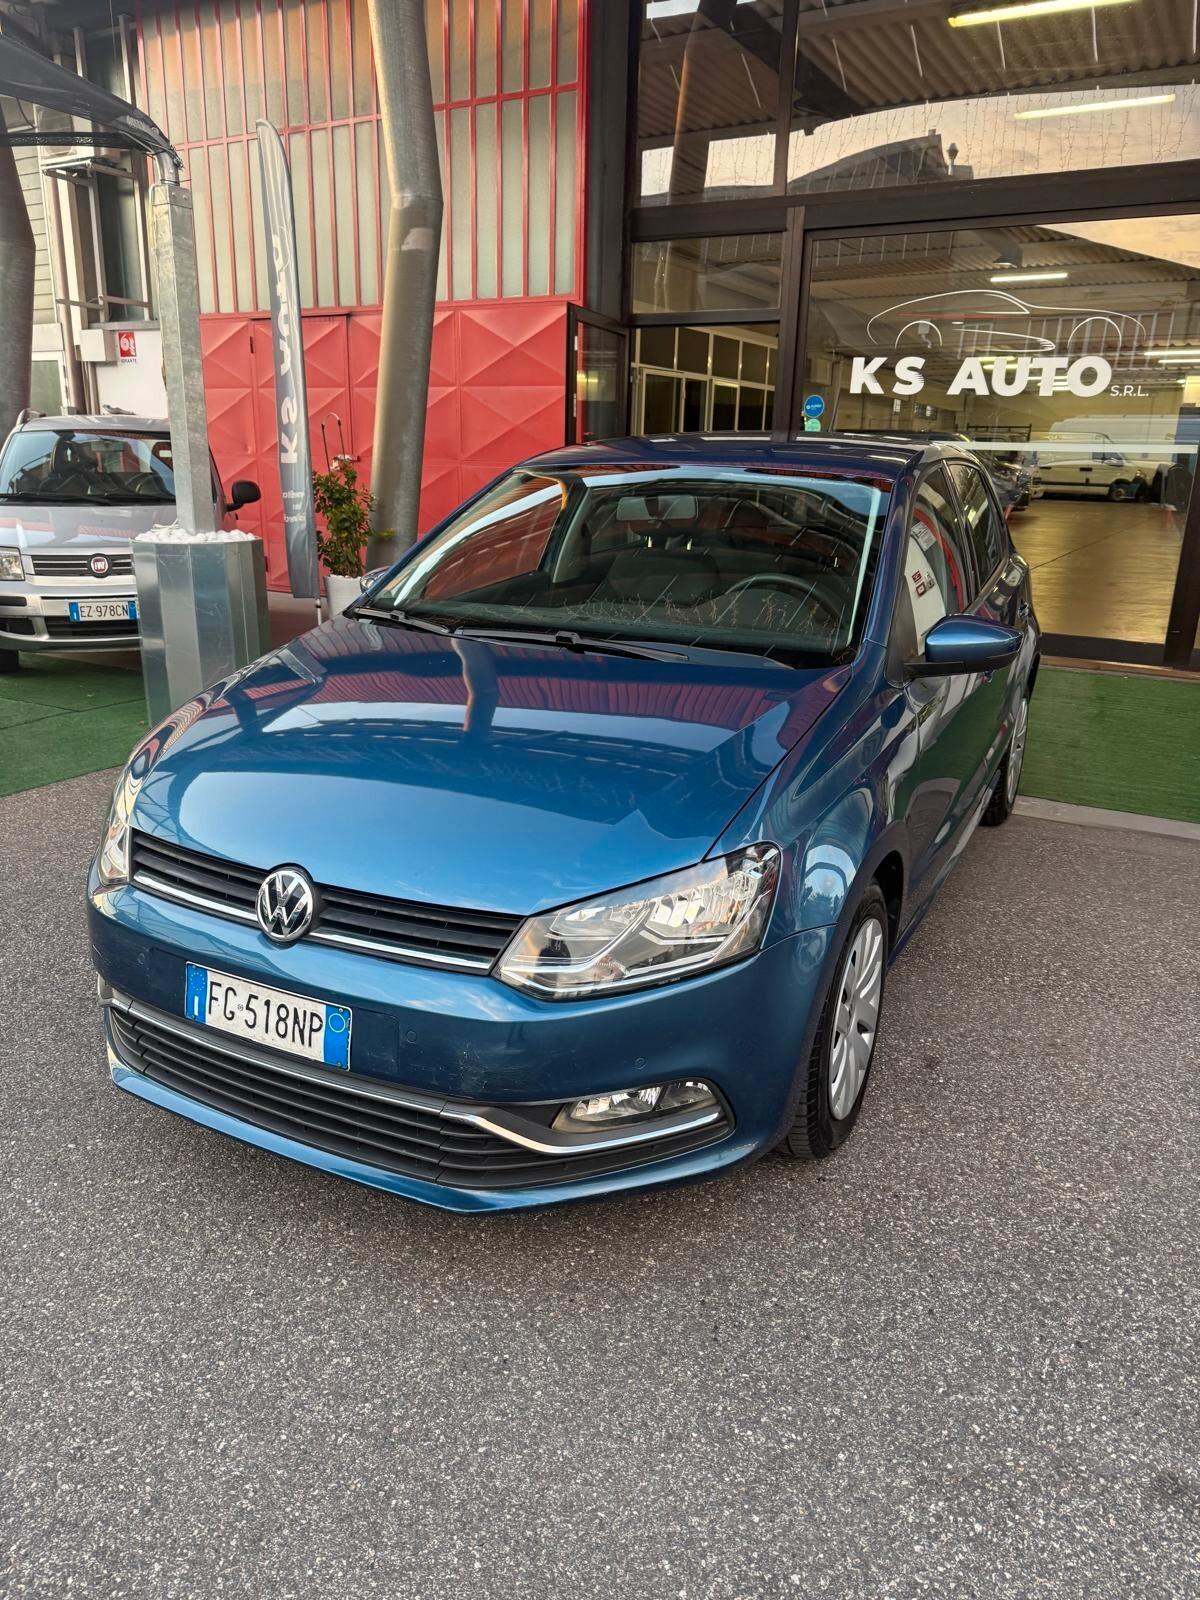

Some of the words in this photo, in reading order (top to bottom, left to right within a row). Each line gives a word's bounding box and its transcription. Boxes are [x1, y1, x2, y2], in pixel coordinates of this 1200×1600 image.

[849, 356, 925, 395] KS
[947, 356, 1112, 397] AUTO
[1110, 384, 1149, 396] S.R.L.
